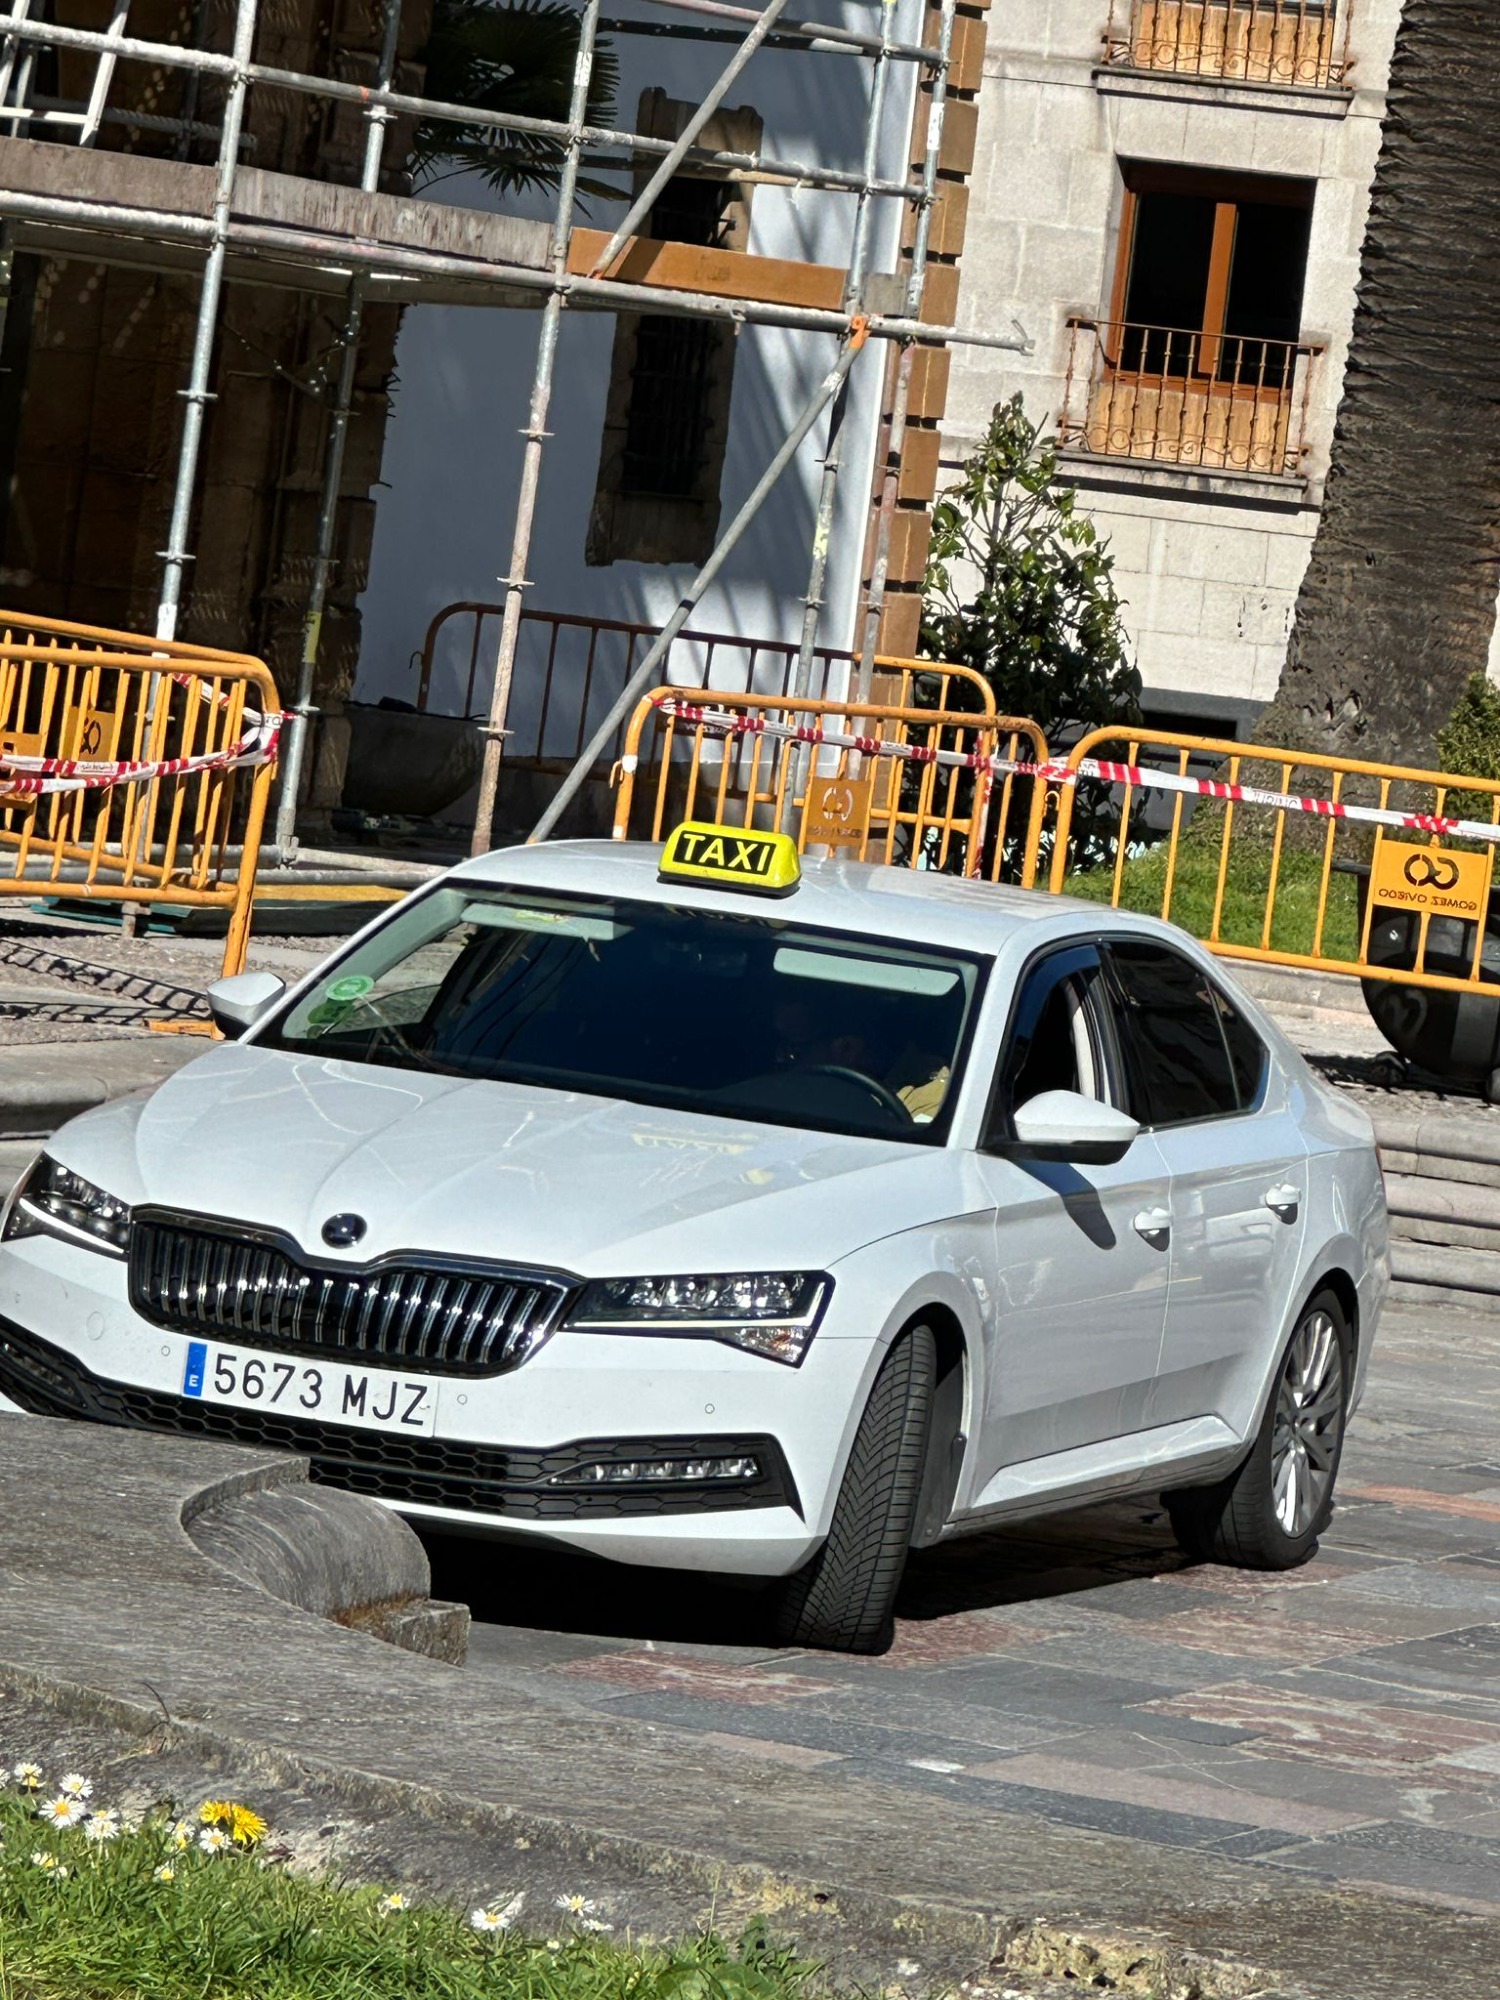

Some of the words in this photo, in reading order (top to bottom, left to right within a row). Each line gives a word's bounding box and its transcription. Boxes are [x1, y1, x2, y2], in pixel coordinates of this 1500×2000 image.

[683, 833, 771, 872] TAXI
[188, 1373, 199, 1388] E
[213, 1352, 323, 1409] 5673
[341, 1373, 428, 1426] MJZ
